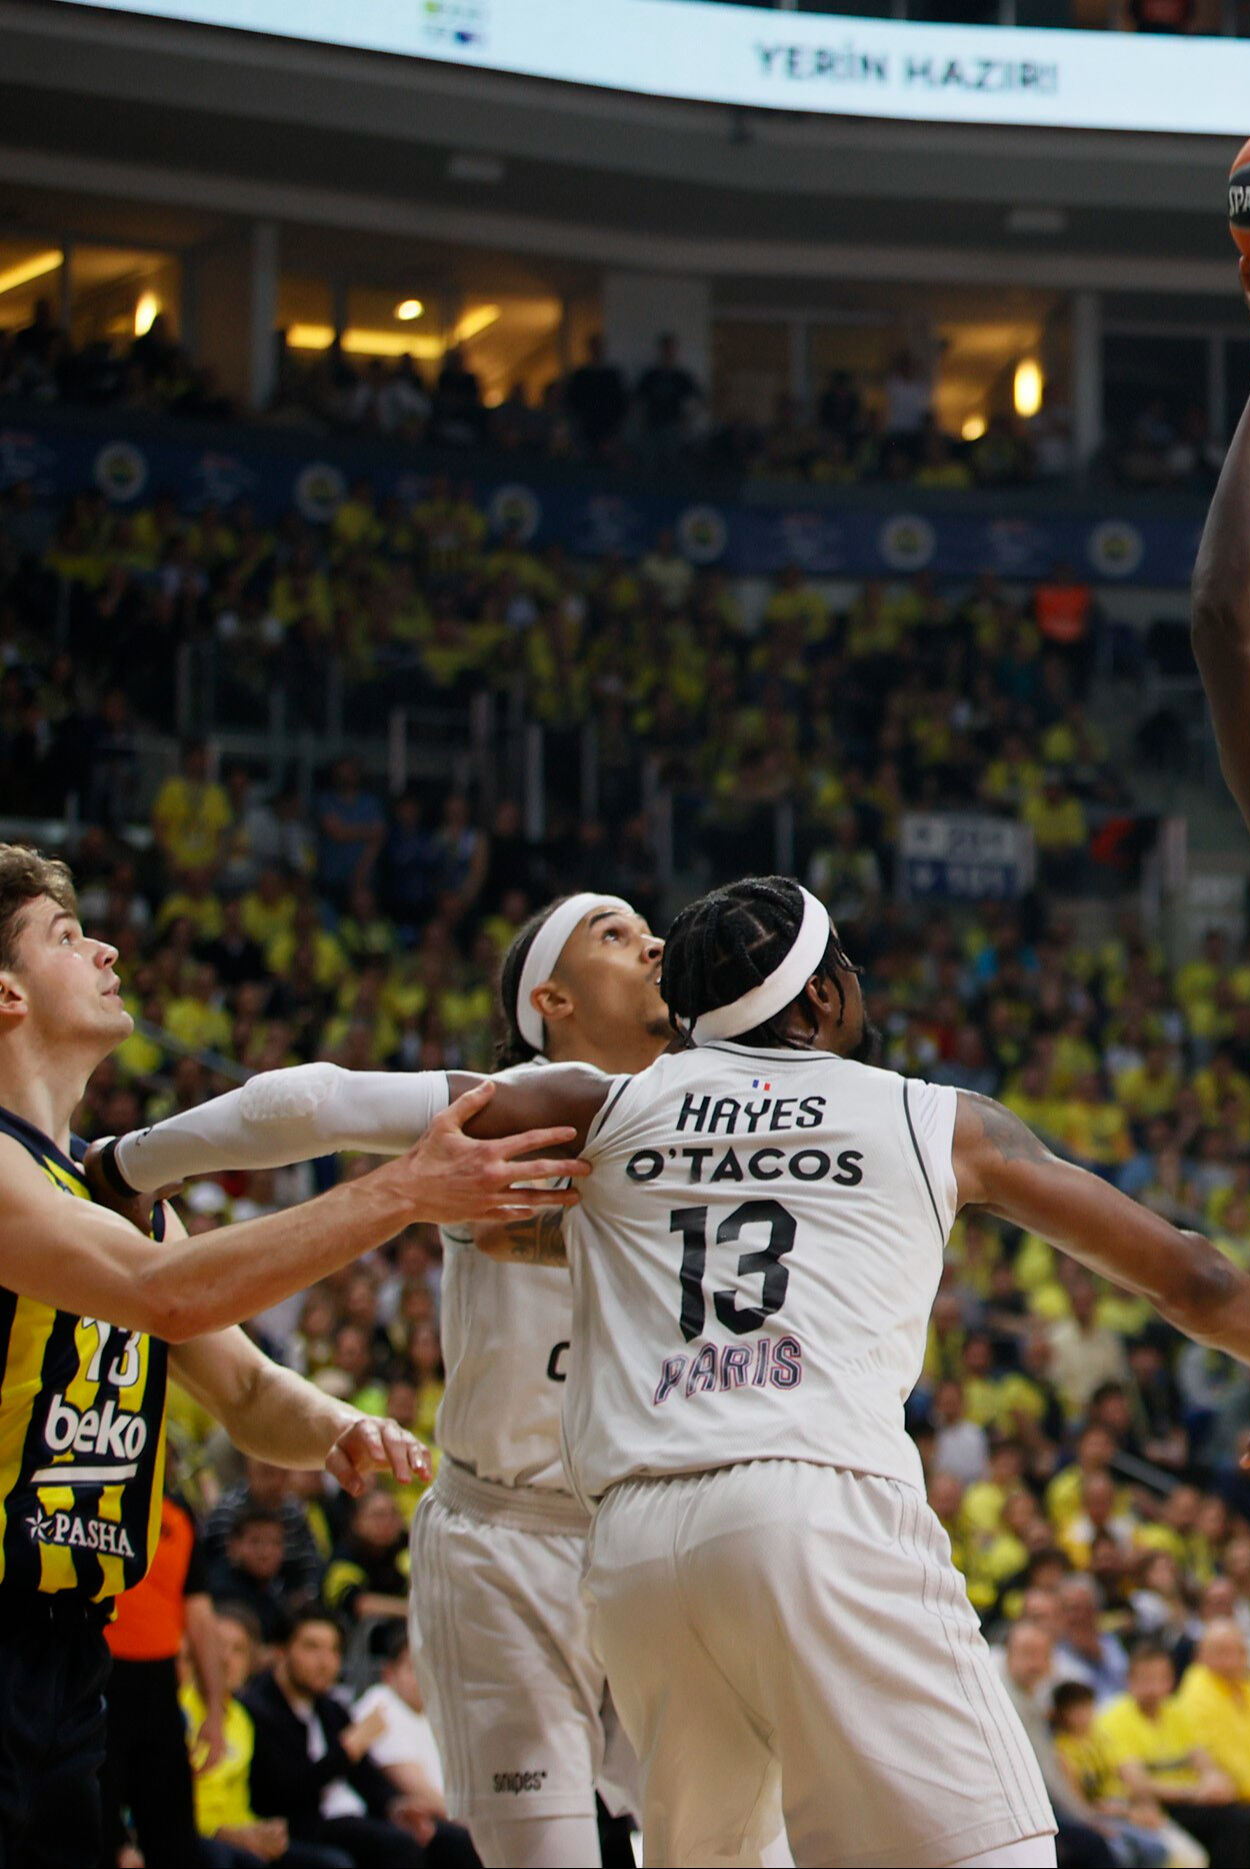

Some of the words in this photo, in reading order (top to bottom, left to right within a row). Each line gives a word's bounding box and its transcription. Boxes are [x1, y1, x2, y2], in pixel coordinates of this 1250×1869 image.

[756, 42, 887, 82] YERİN
[676, 1092, 827, 1134] HAYES
[626, 1146, 864, 1186] O'TACOS
[670, 1199, 798, 1343] 13
[653, 1336, 802, 1407] PARIS
[45, 1394, 147, 1460] beko
[54, 1513, 135, 1558] PASHA
